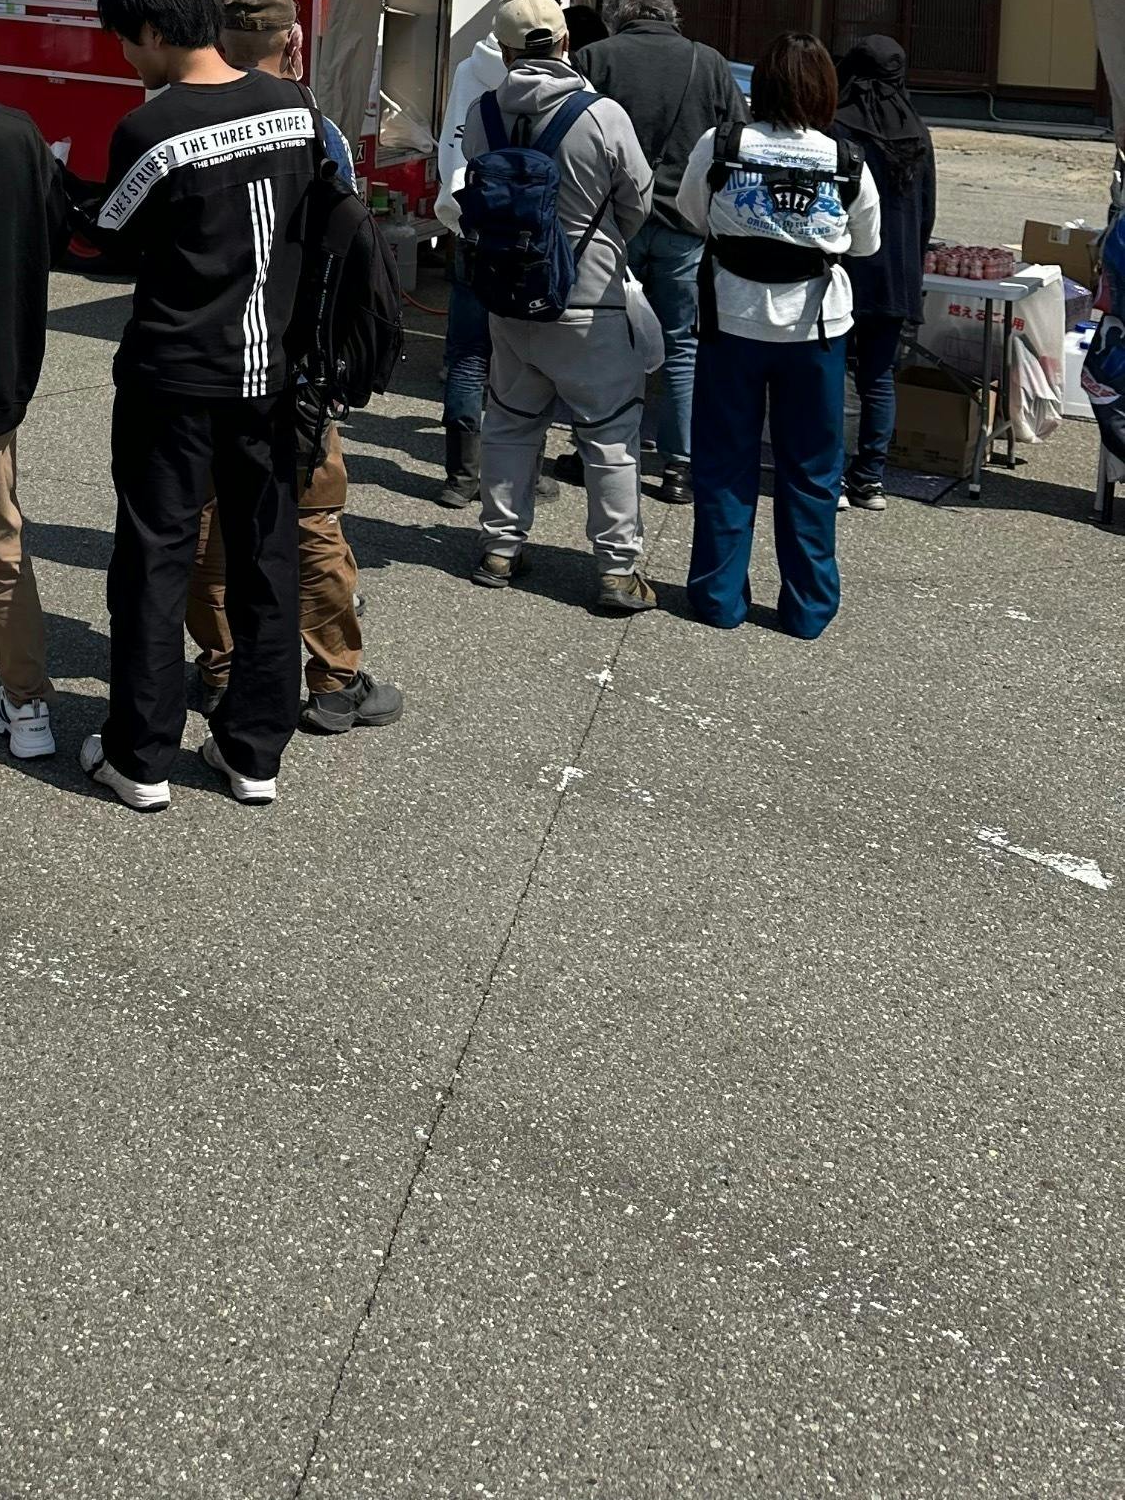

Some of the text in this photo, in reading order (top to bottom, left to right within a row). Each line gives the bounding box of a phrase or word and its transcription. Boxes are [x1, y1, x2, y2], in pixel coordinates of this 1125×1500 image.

[180, 115, 307, 156] THE THREE STRIPES
[192, 159, 210, 169] THE
[210, 153, 234, 166] BRAND
[234, 148, 257, 159] WITH
[257, 143, 275, 153] THE
[105, 151, 169, 221] THE 3 STRIPES
